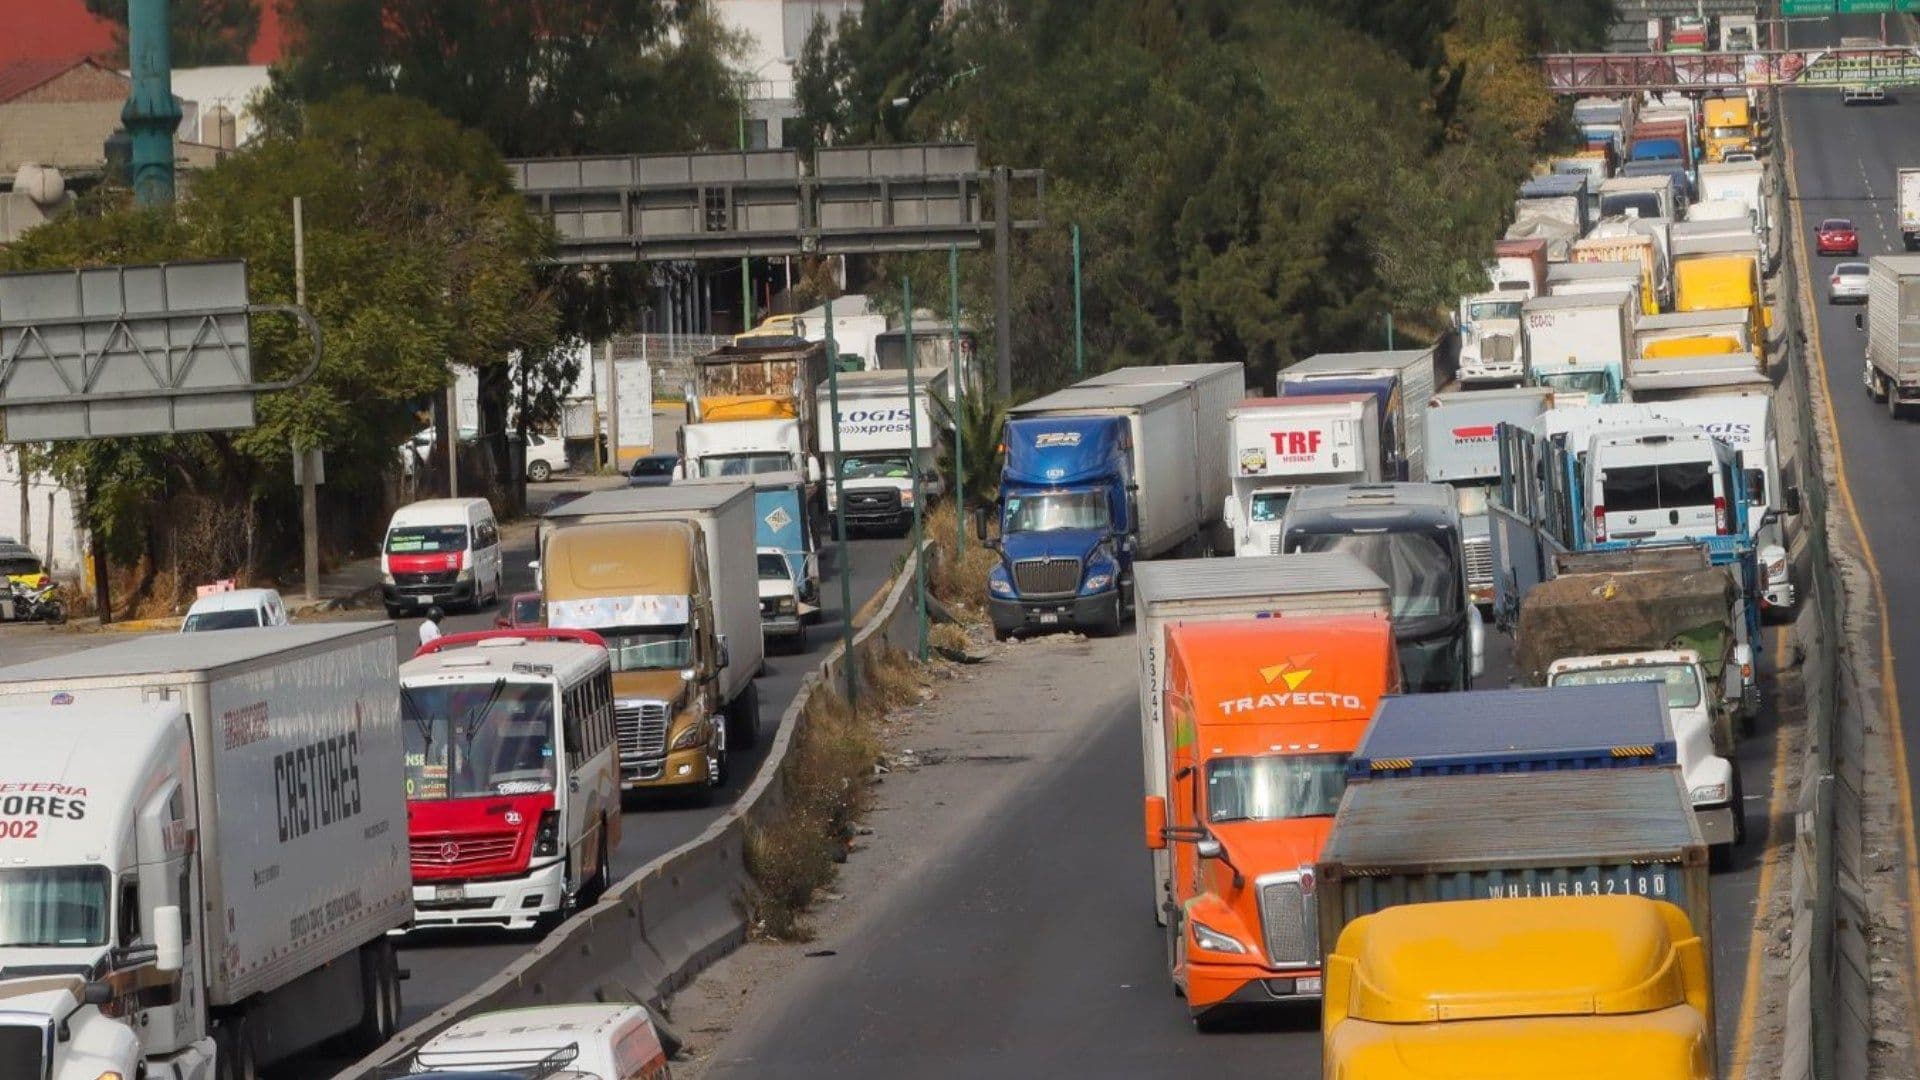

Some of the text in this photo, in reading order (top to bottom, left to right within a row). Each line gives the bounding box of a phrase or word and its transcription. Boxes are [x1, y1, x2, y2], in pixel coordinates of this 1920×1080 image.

[1270, 430, 1321, 455] TRF
[1218, 692, 1361, 715] TRAYECTO
[274, 731, 361, 843] CASTORES
[0, 795, 86, 820] ORES
